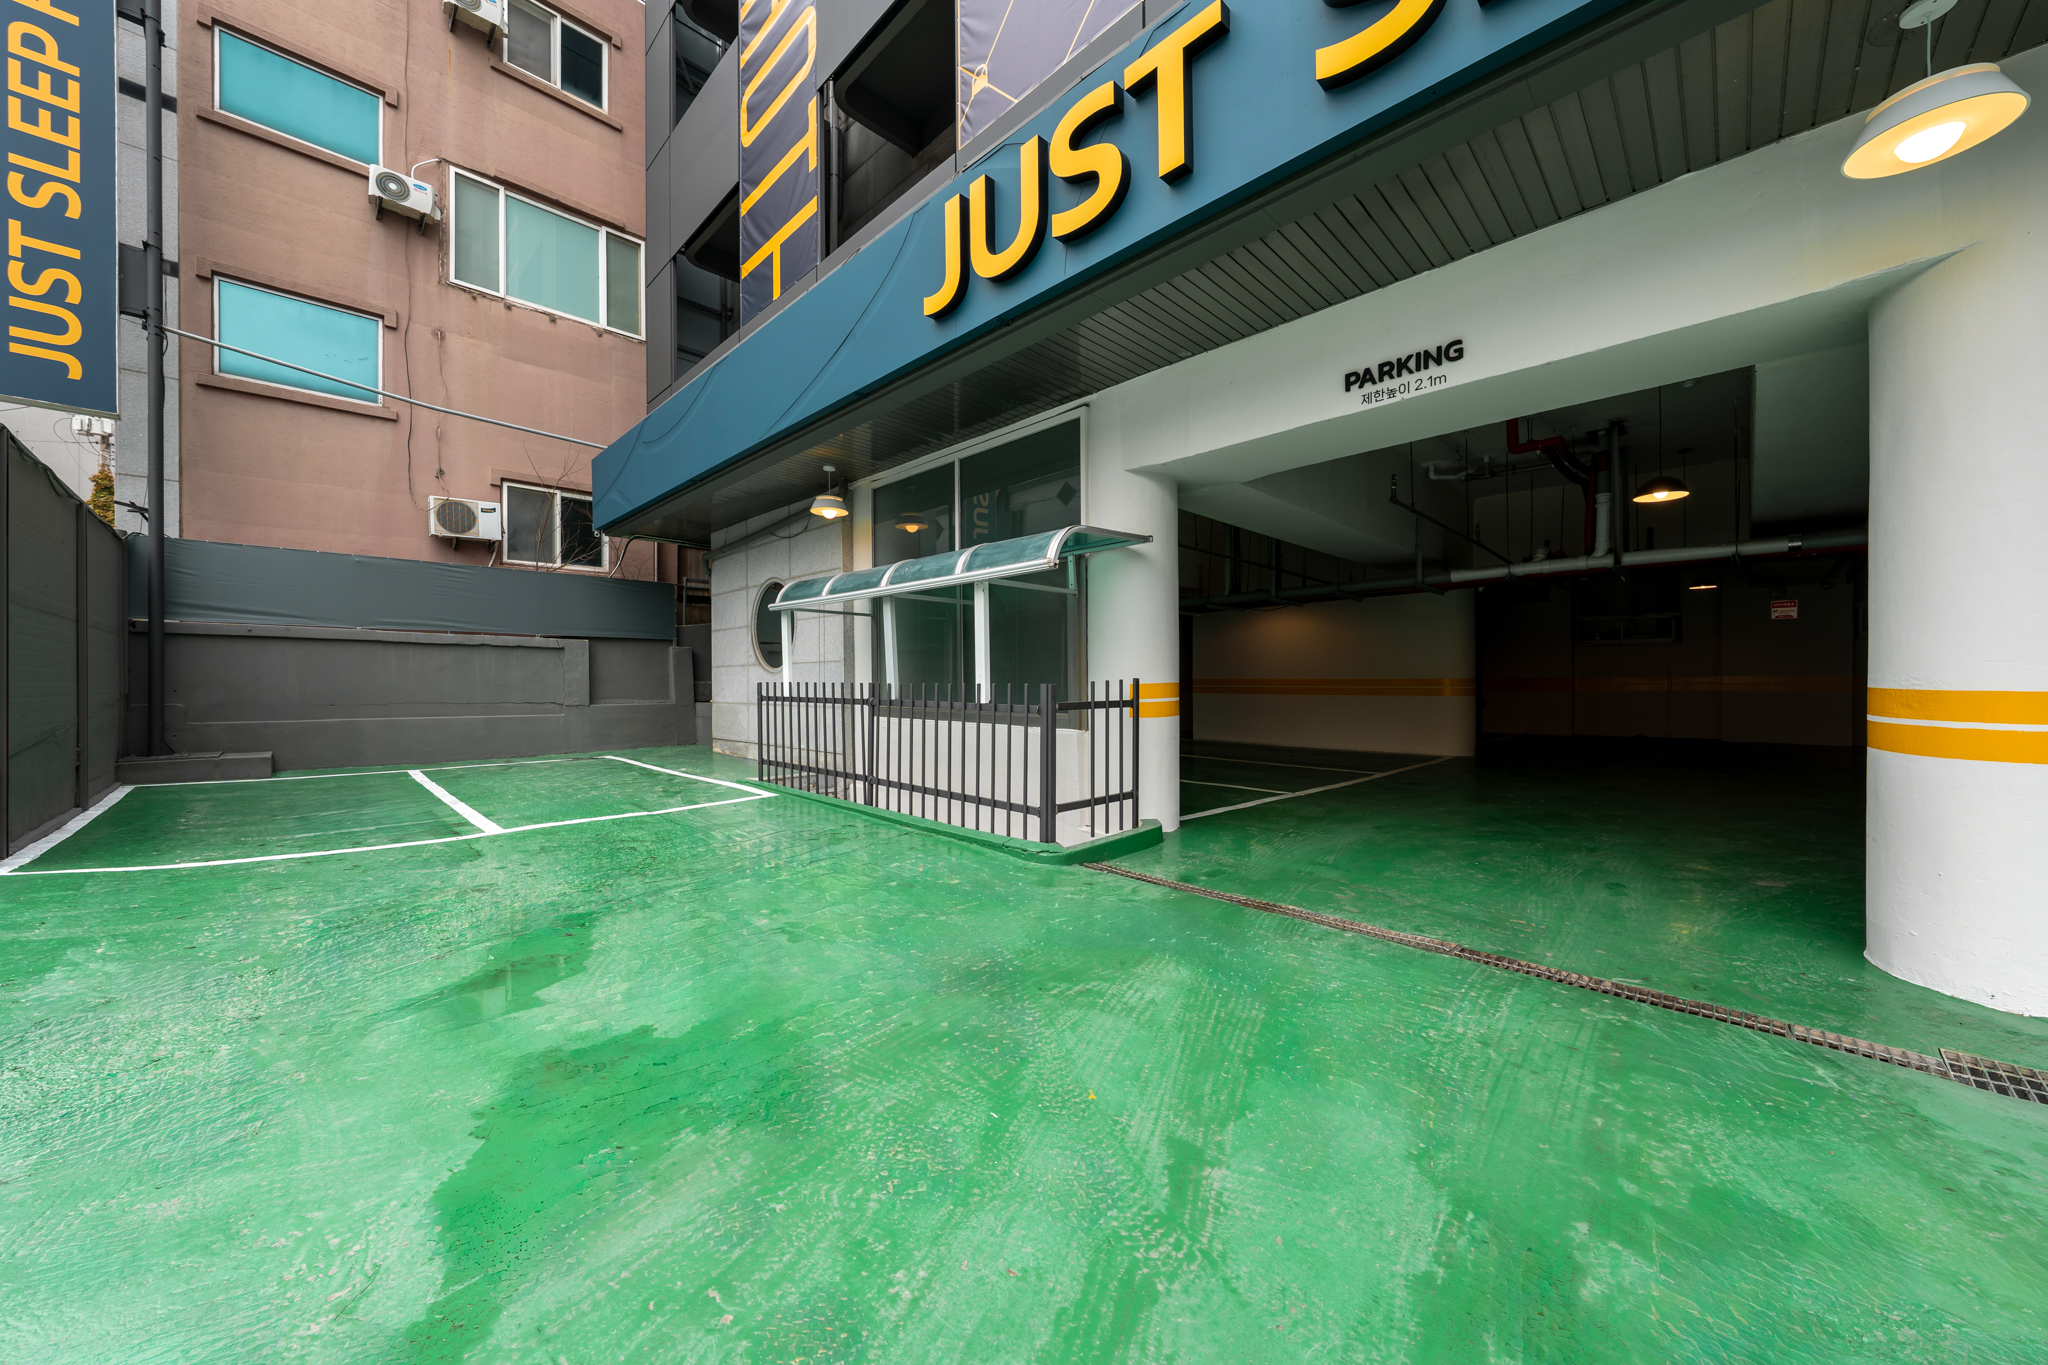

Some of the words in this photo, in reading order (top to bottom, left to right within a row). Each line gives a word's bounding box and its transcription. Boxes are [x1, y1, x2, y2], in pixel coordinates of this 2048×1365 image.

[7, 21, 82, 219] SLEEP
[923, 0, 1229, 319] JUST
[7, 219, 82, 381] JUST
[1344, 339, 1464, 392] PARKING
[1361, 381, 1411, 405] 제한높이
[1414, 374, 1447, 392] 2.1m
